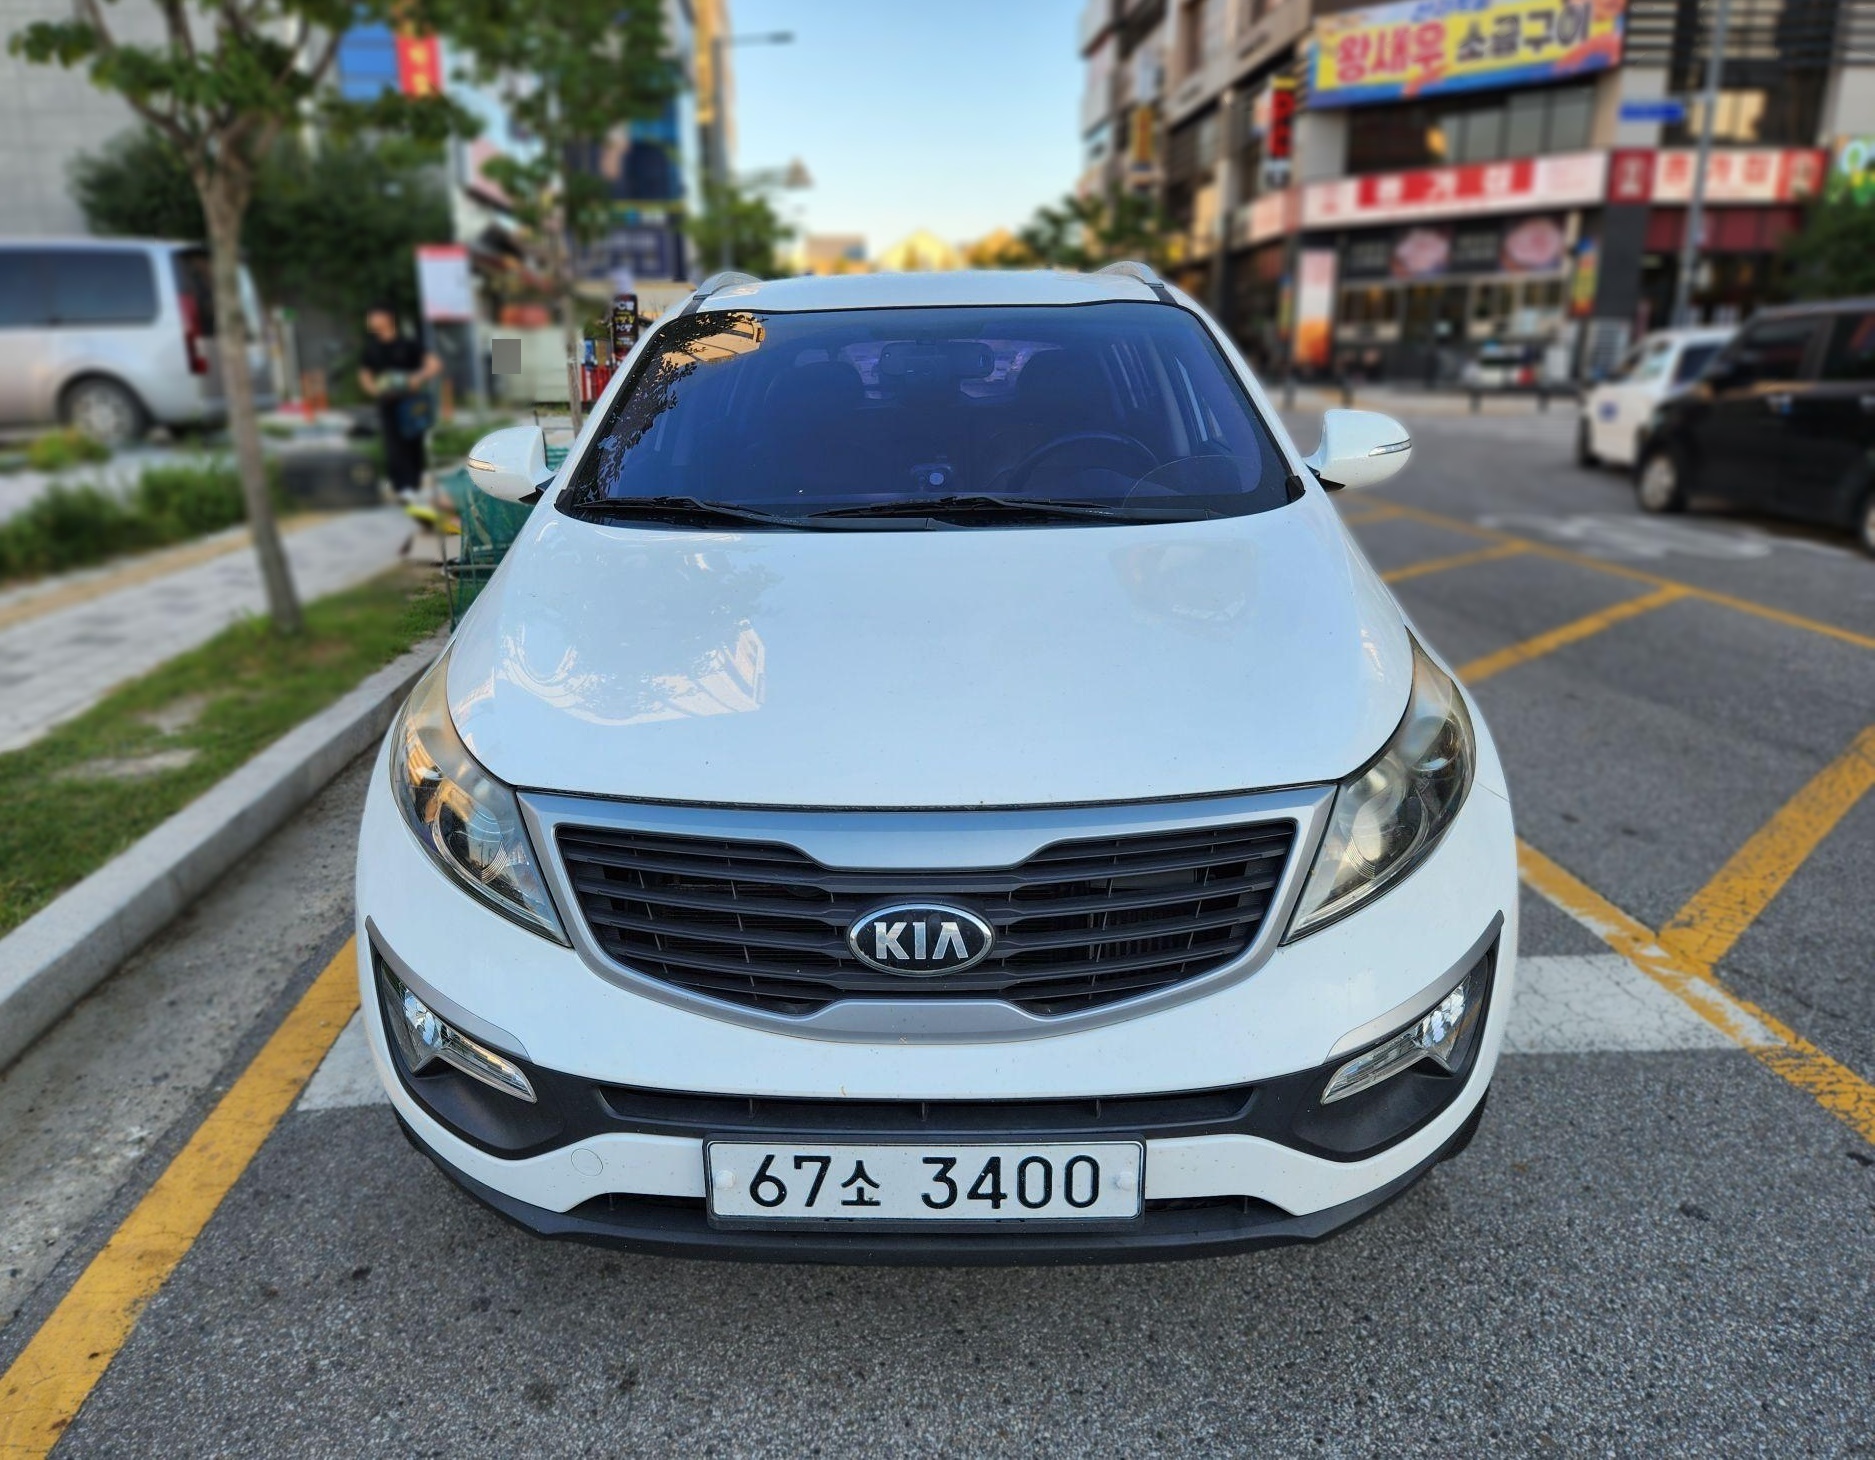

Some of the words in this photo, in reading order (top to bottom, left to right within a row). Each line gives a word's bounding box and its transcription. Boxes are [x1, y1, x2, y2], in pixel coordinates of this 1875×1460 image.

[1336, 21, 1447, 83] 왕새우
[873, 921, 969, 960] KIA
[748, 1153, 882, 1208] 67소
[920, 1155, 1101, 1210] 3400
